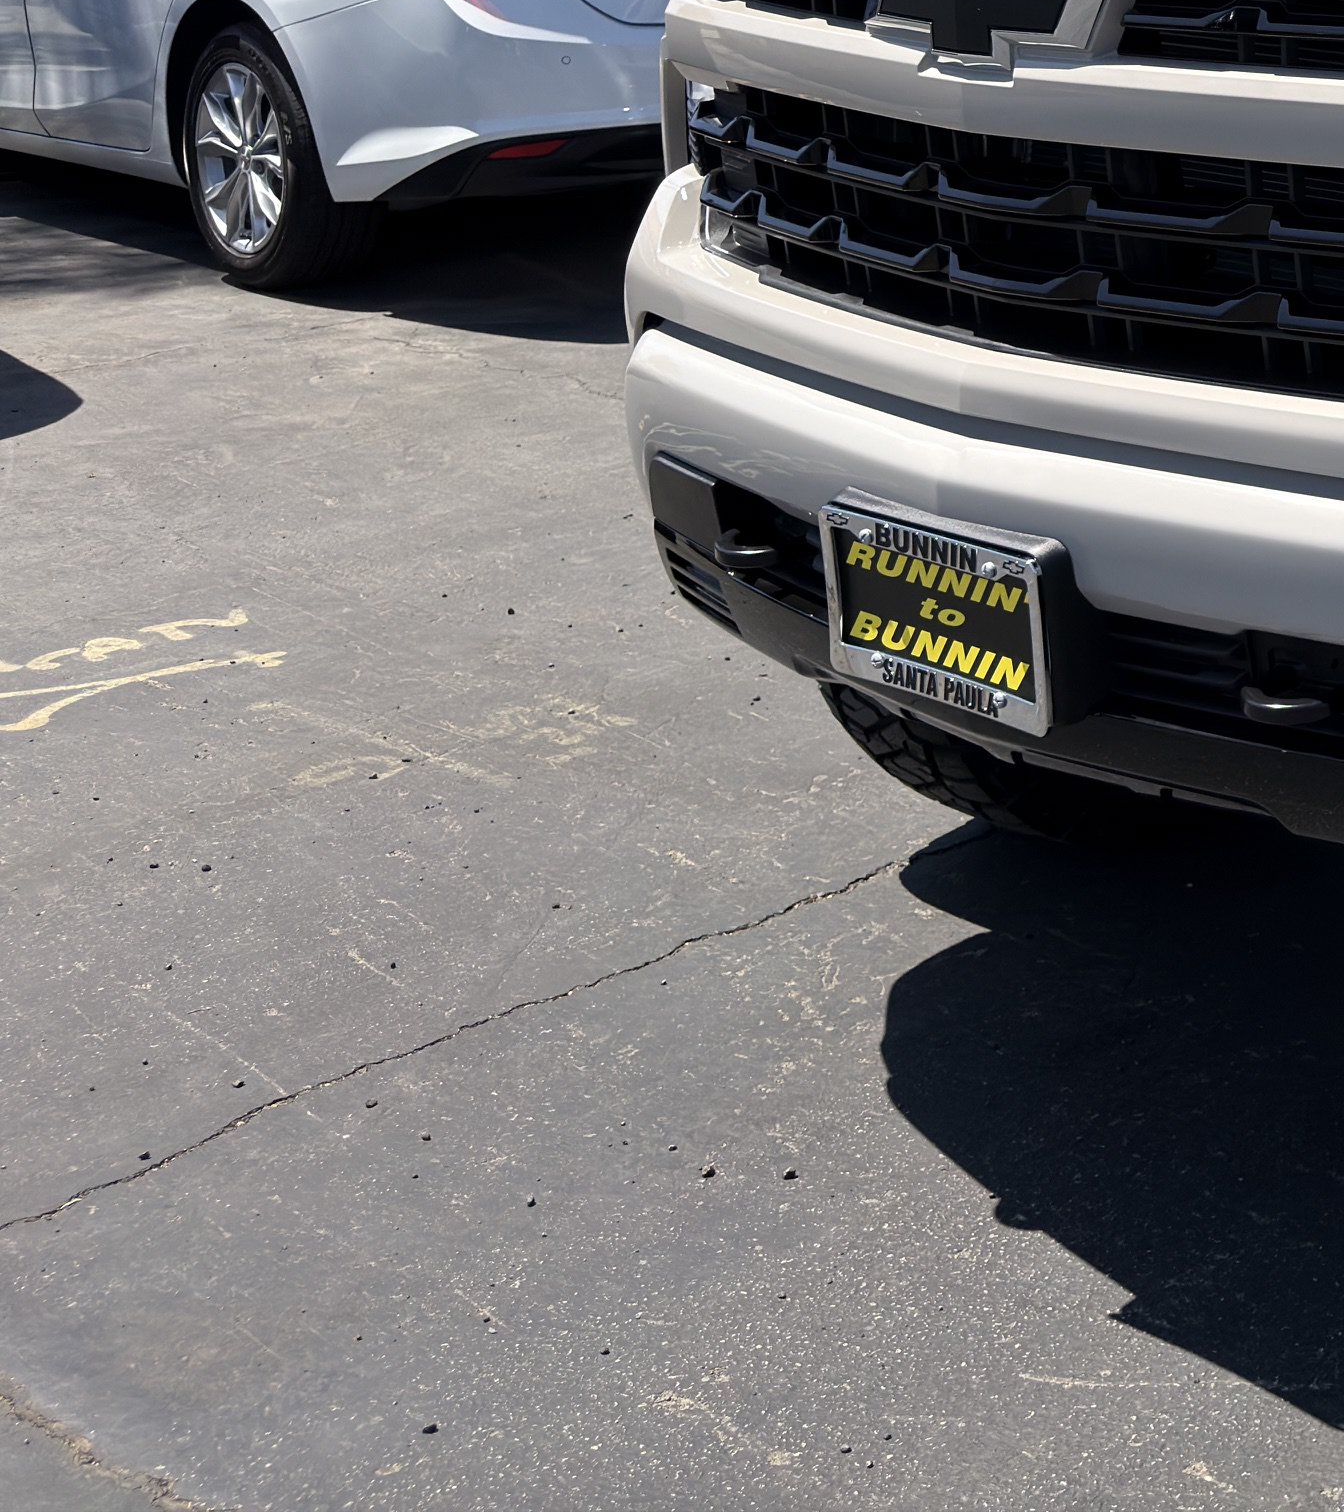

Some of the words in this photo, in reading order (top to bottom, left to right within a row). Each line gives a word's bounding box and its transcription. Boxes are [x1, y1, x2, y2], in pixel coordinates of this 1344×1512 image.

[874, 522, 978, 574] BUNNIN
[919, 597, 966, 627] to
[850, 610, 1030, 691] BUNNIN
[882, 656, 939, 698] SANTA
[943, 676, 999, 719] PAULA
